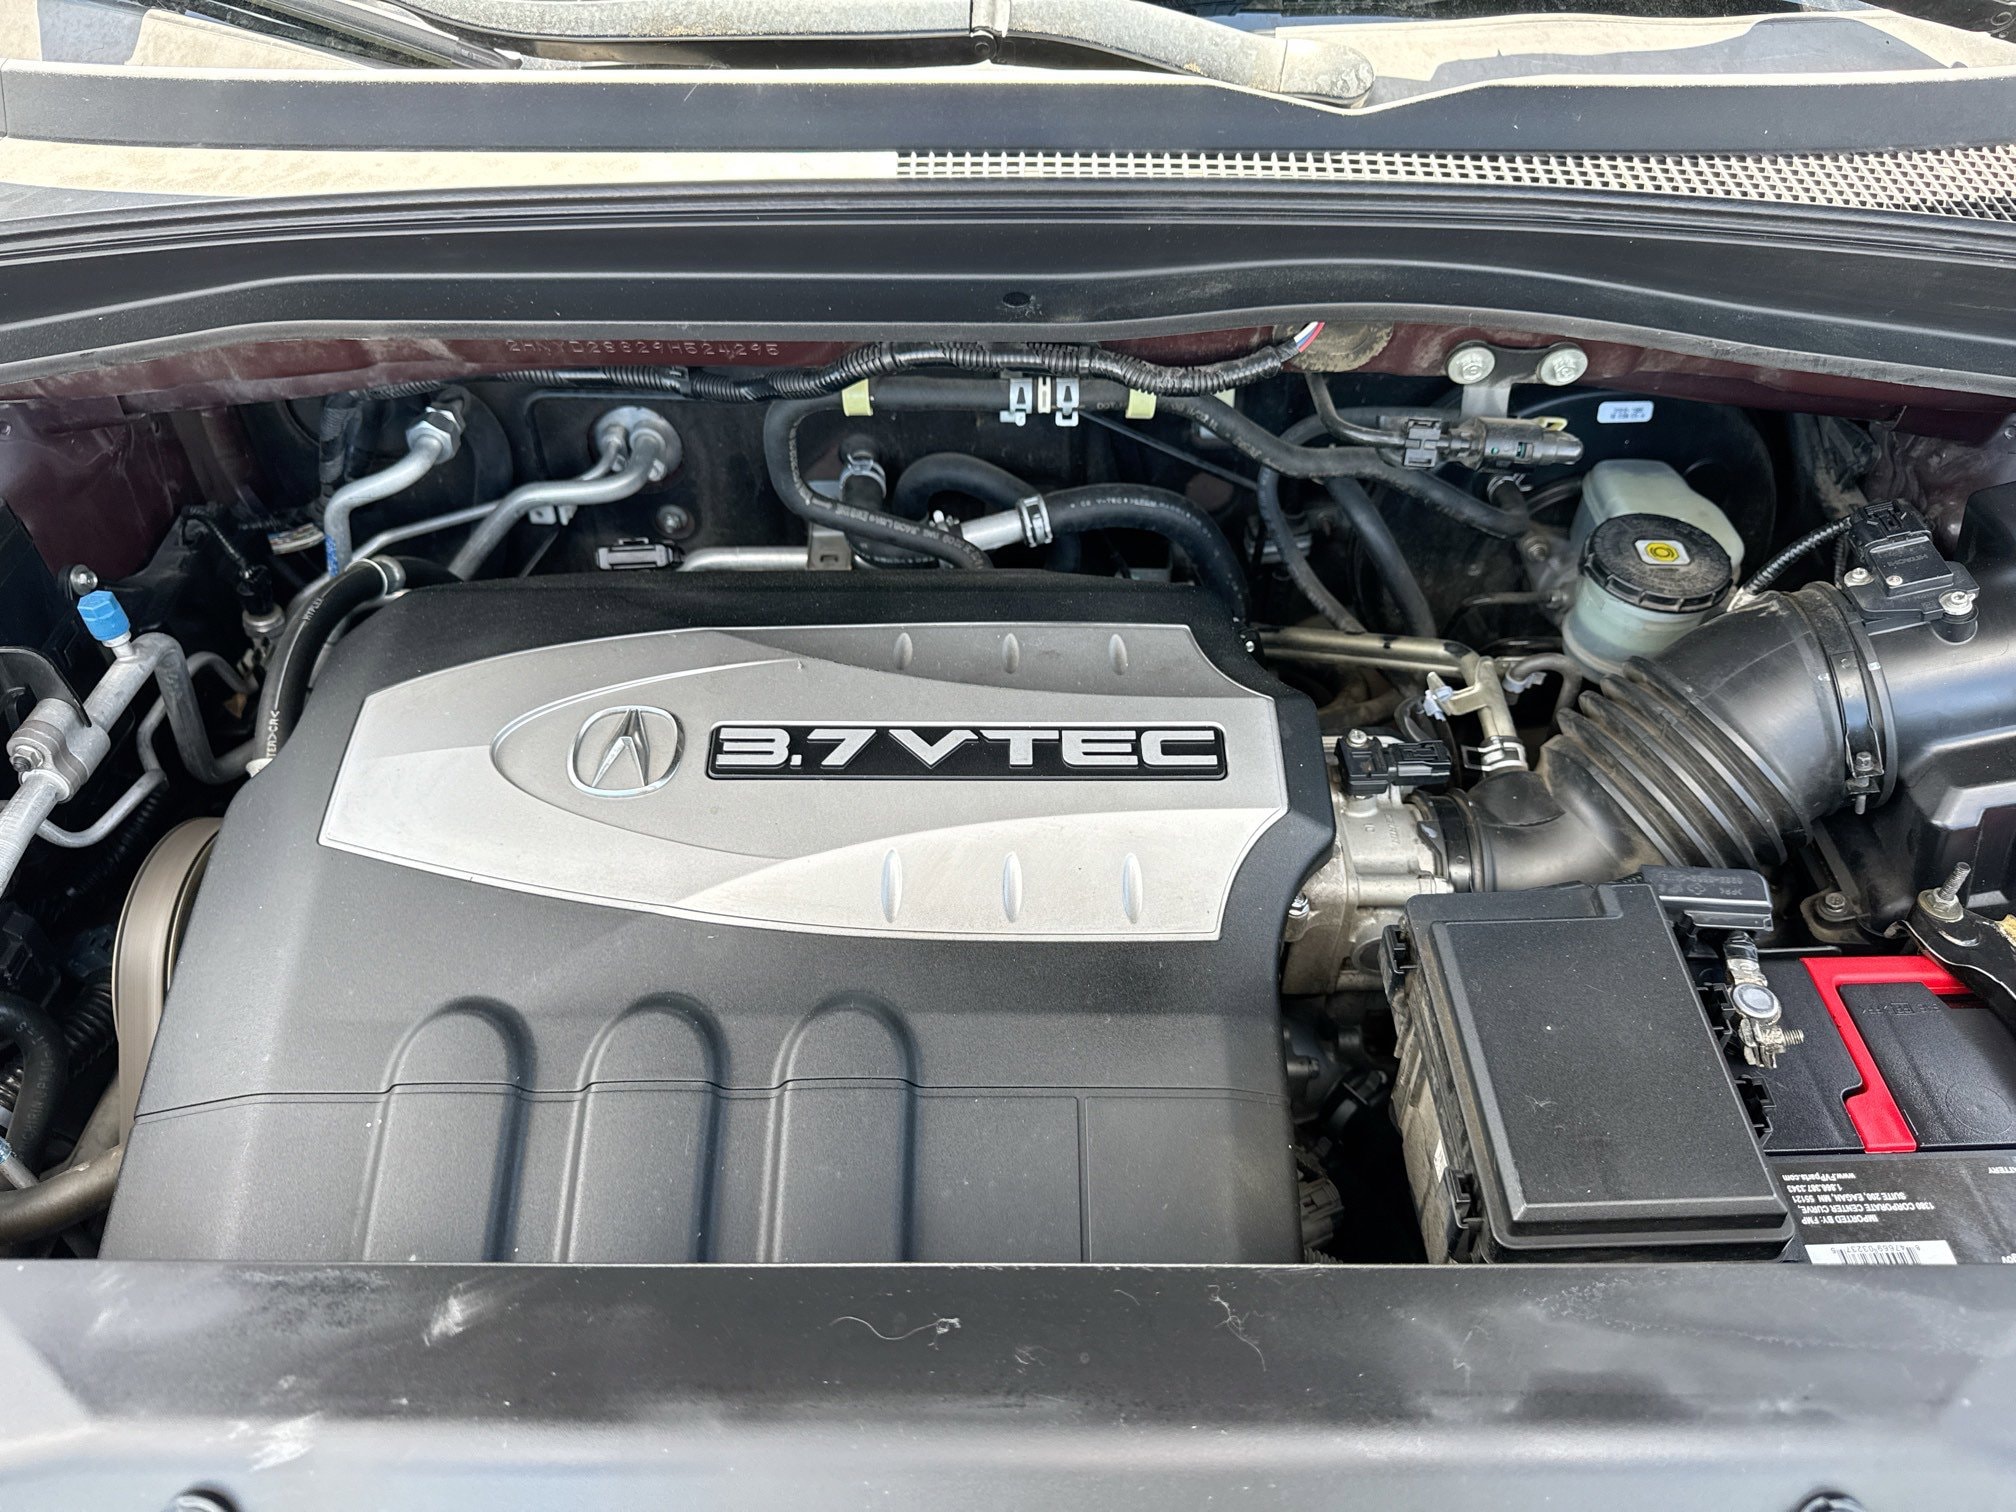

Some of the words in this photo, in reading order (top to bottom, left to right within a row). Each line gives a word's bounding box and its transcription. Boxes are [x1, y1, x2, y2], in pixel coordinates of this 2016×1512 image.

[1782, 1172, 1856, 1181] www.FVPparts.com
[1791, 1195, 1815, 1204] 55121
[1817, 1195, 1831, 1203] MN
[1831, 1192, 1863, 1202] EAGAN,
[1881, 1191, 1907, 1200] SUITE
[1797, 1205, 1830, 1214] CURVE,
[1830, 1203, 1864, 1213] CENTER
[1865, 1202, 1916, 1212] CORPORATE
[1801, 1216, 1819, 1225] FMP
[1819, 1215, 1834, 1224] BY:
[1834, 1214, 1879, 1224] IMPORTED
